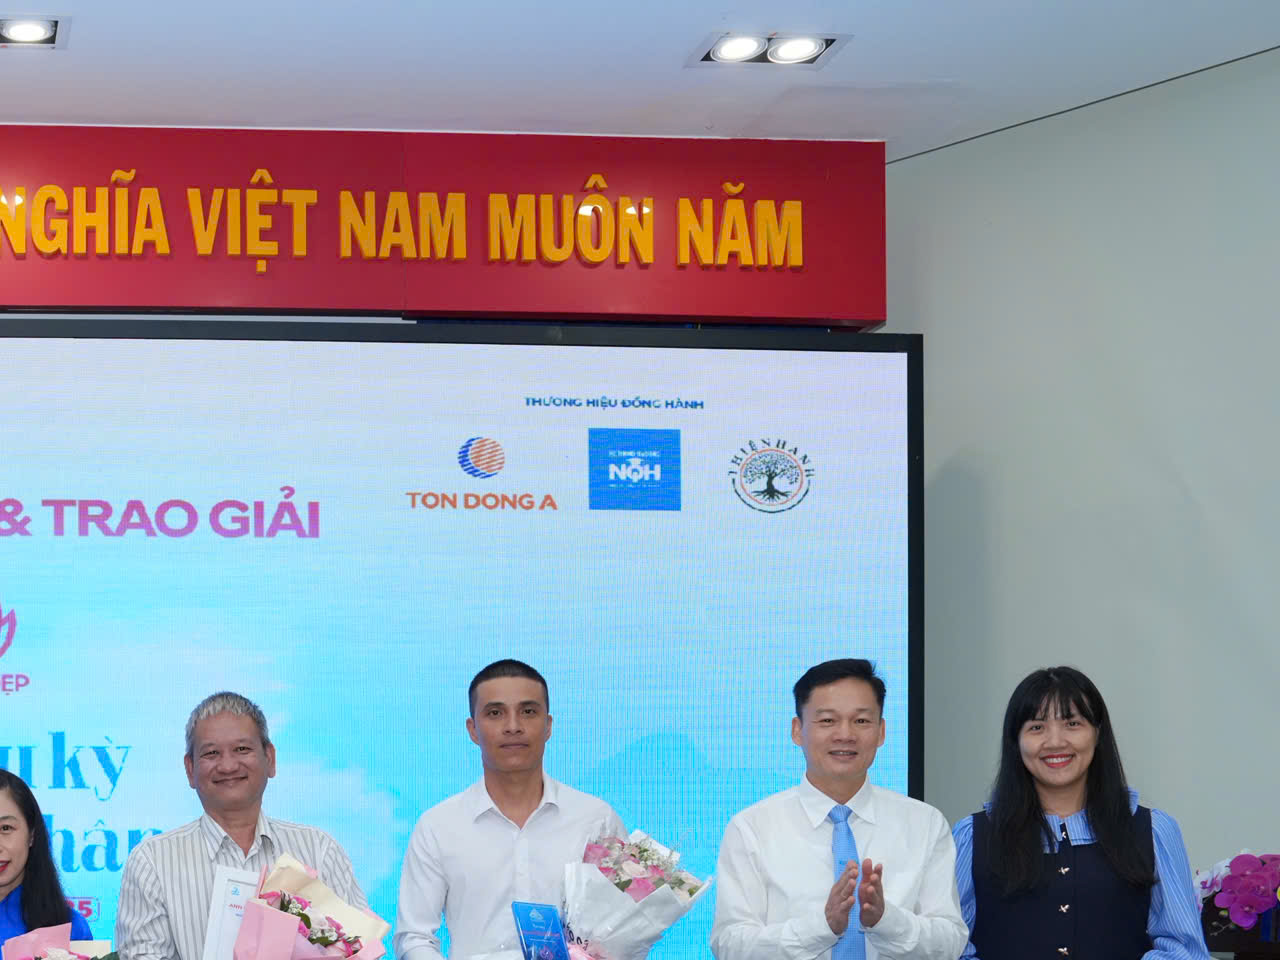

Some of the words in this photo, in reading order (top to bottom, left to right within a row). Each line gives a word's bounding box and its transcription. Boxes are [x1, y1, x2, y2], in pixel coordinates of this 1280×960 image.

[187, 169, 318, 273] VIỆT
[339, 190, 468, 259] NAM
[488, 174, 655, 266] MUÔN
[678, 181, 804, 268] NĂM
[41, 499, 199, 538] TRAO
[209, 485, 321, 538] GIẢI
[406, 492, 457, 509] TON
[463, 492, 535, 510] DONG
[538, 494, 558, 510] A
[48, 731, 133, 801] kỳ
